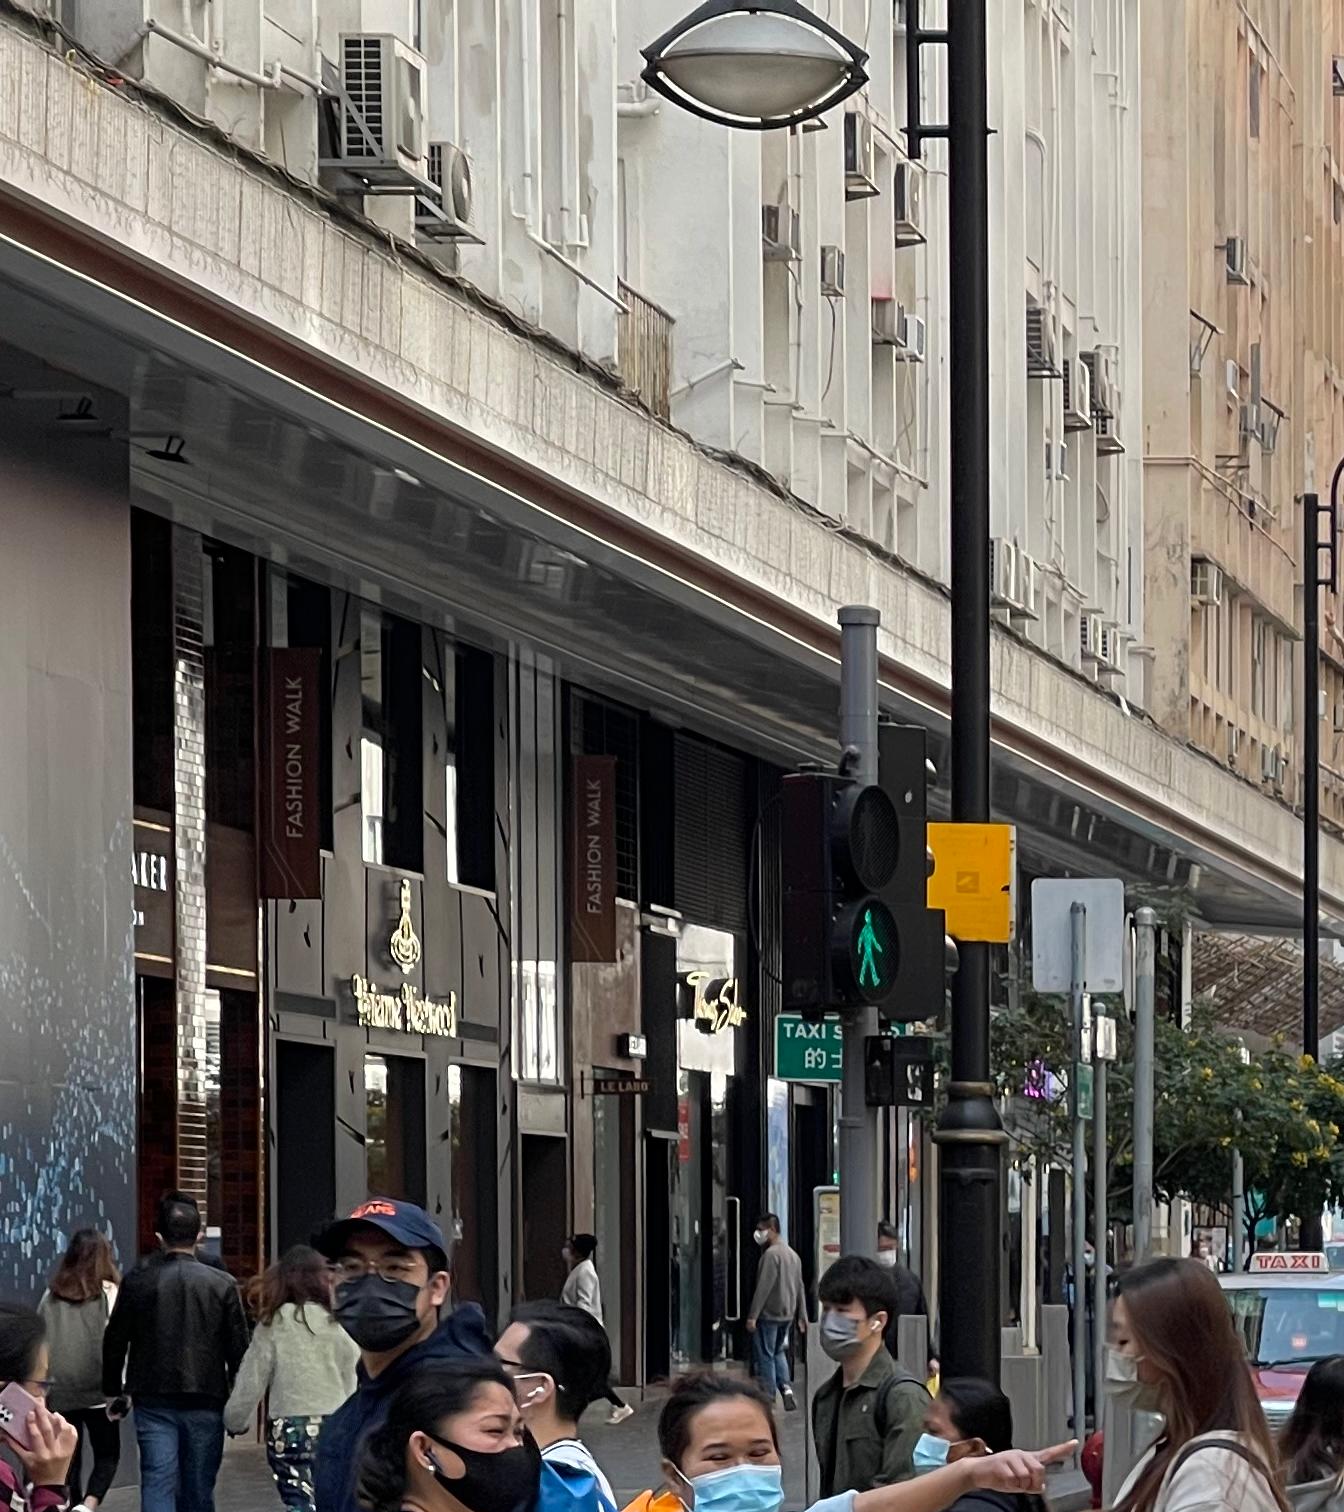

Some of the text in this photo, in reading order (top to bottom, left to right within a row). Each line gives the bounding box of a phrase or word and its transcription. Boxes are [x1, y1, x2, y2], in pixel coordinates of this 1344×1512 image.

[285, 676, 303, 838] FASHION WALK
[586, 778, 602, 914] FASHION WALK
[783, 1023, 826, 1039] TAXI
[601, 1080, 616, 1092] LE
[1256, 1255, 1321, 1269] TAXI
